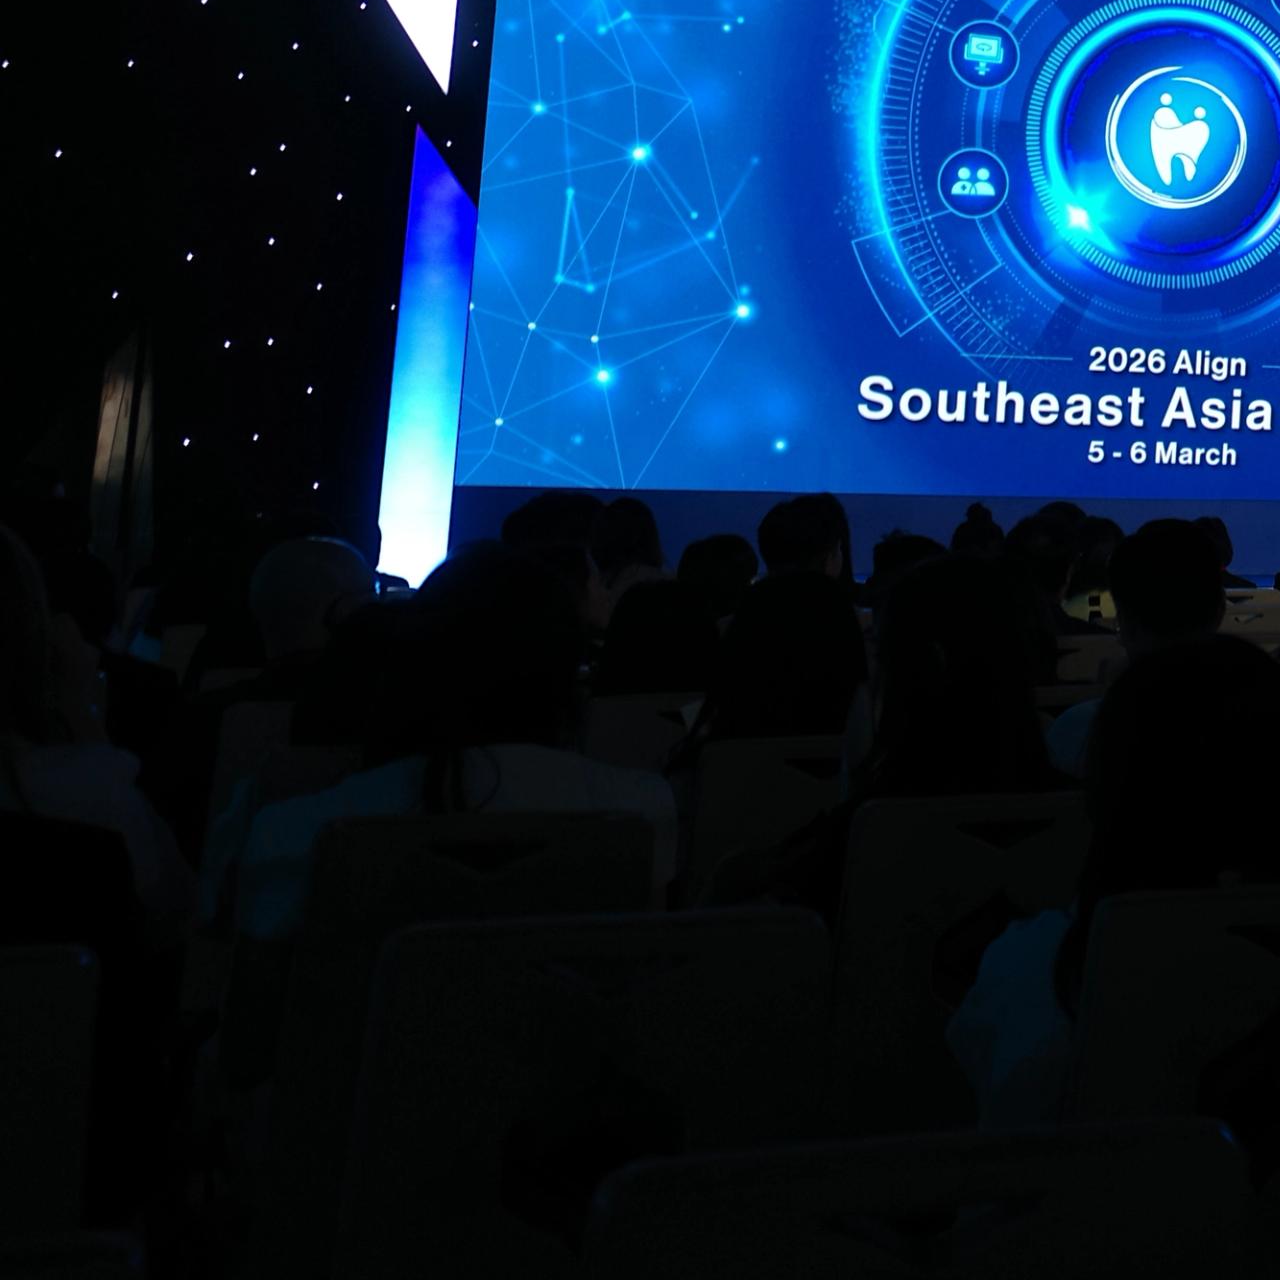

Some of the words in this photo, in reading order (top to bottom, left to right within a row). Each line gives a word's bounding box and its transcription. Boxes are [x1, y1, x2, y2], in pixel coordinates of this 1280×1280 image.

[1089, 346, 1166, 374] 2026
[1173, 351, 1247, 380] Align
[857, 375, 1145, 428] Southeast
[1162, 386, 1272, 430] Asia
[1087, 441, 1105, 463] 5
[1129, 442, 1147, 464] 6
[1155, 442, 1237, 467] March
